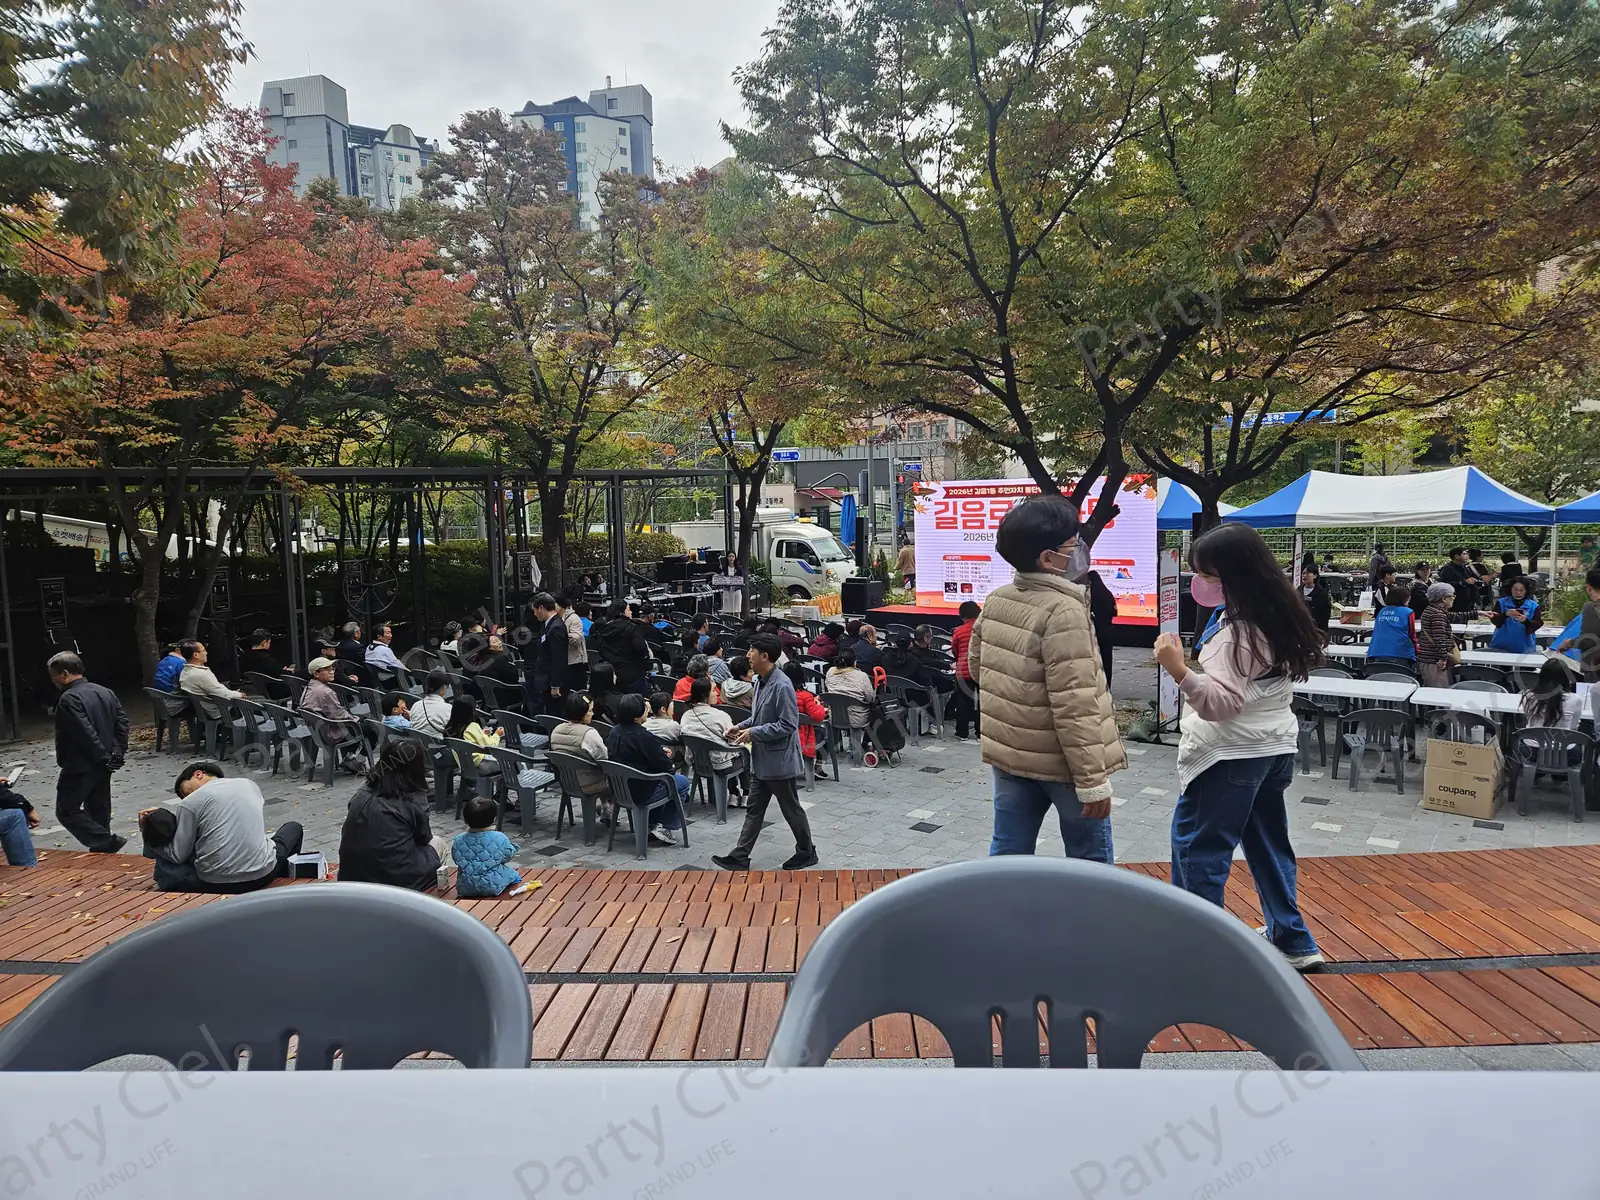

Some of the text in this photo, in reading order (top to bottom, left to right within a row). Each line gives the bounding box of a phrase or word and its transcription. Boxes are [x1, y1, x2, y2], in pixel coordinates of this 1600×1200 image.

[948, 488, 973, 496] 2026년
[963, 533, 994, 542] 2026년
[1438, 784, 1477, 798] coupang
